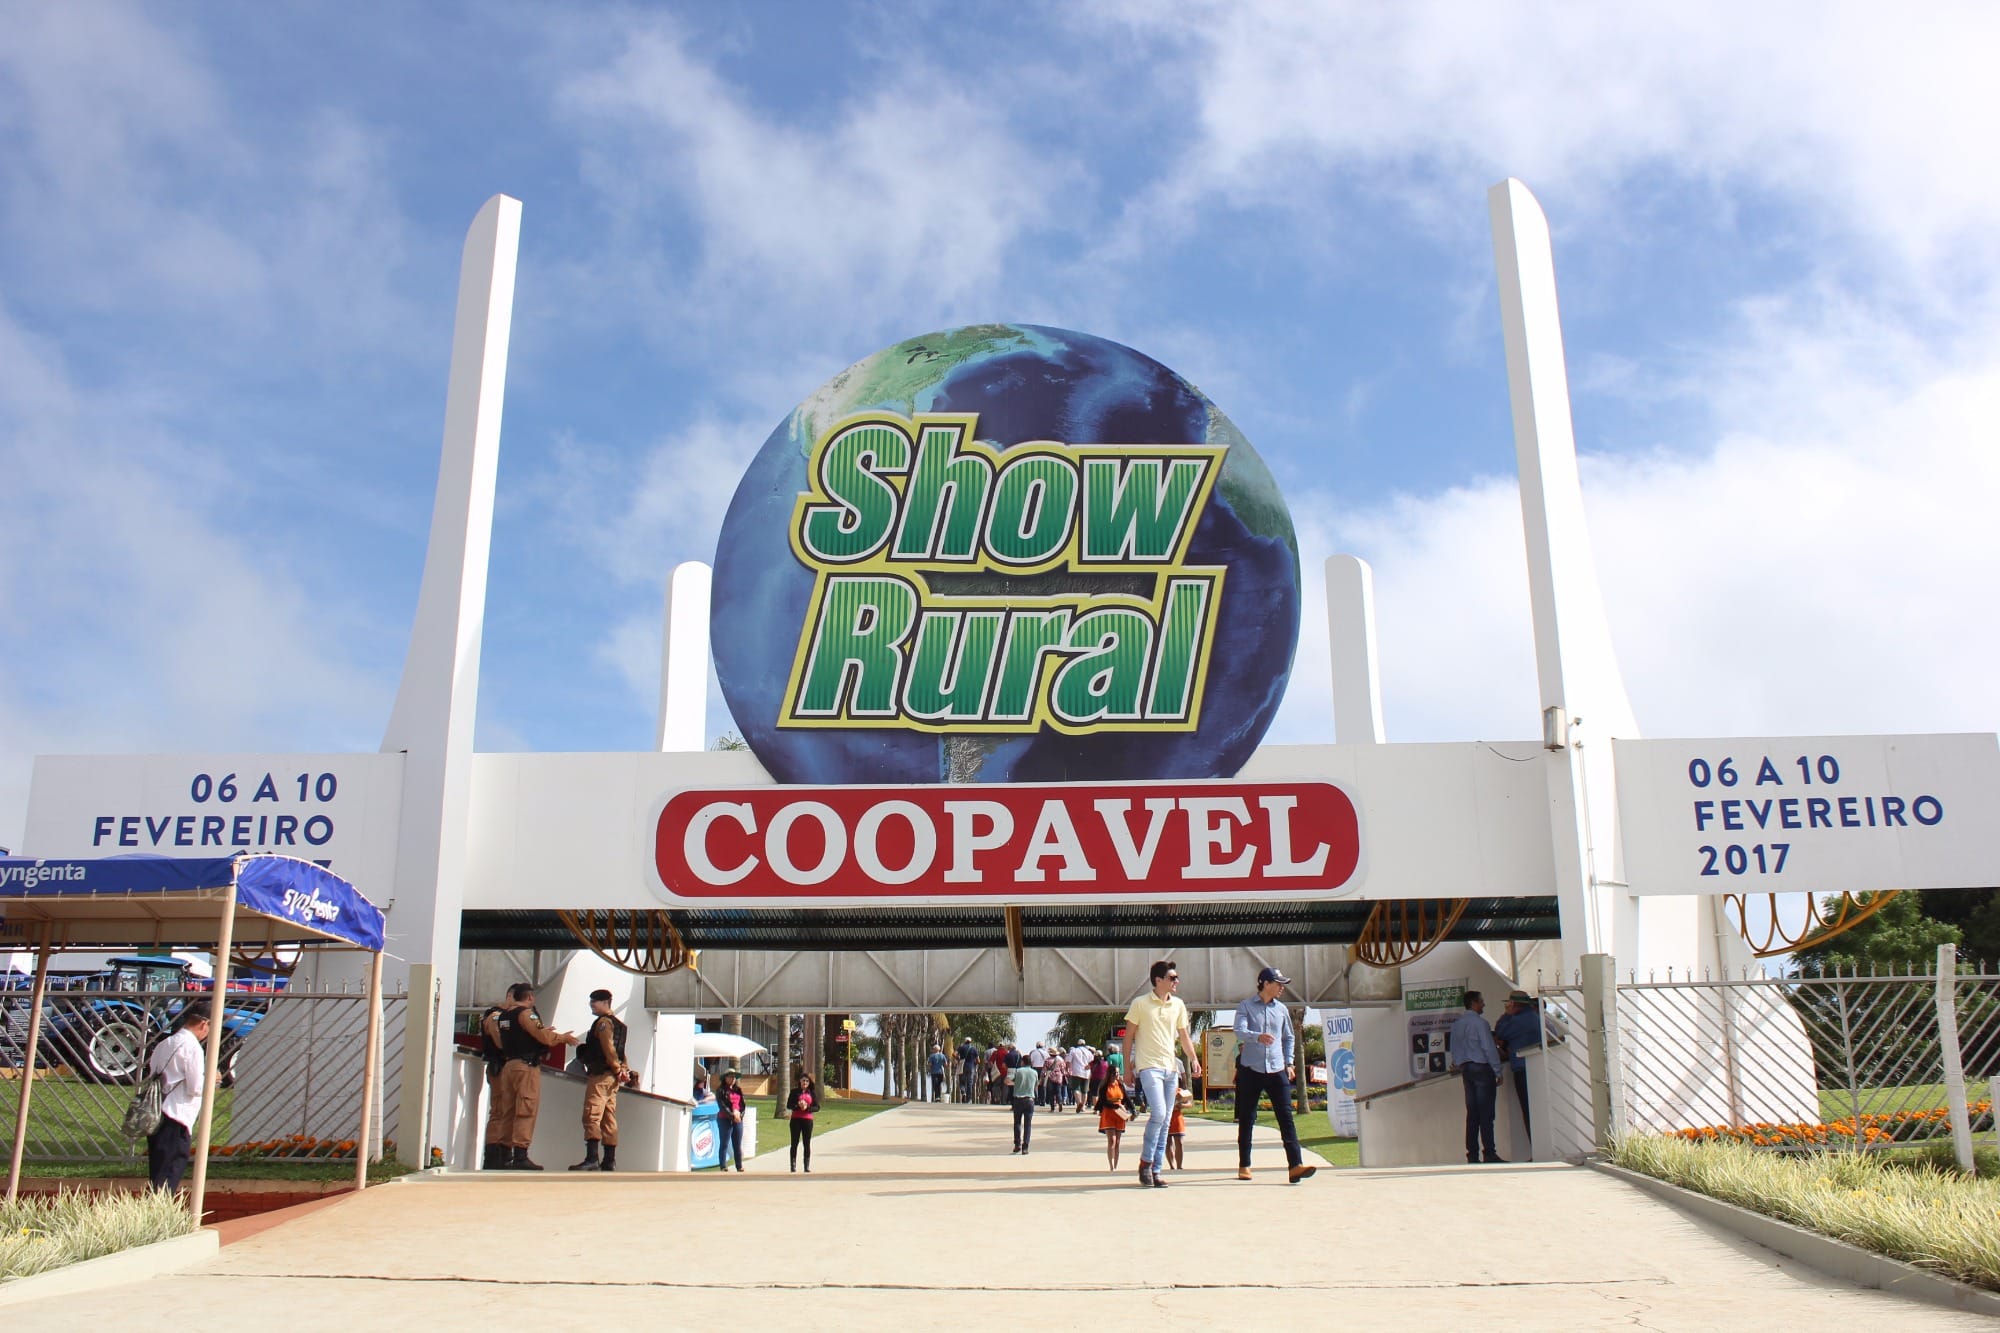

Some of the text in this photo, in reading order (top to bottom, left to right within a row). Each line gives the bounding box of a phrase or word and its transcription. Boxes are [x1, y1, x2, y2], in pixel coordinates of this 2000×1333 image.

[801, 422, 1210, 563] Show
[795, 574, 1211, 722] Rural
[190, 772, 338, 803] 06 A 10
[1688, 754, 1840, 788] 06 A 10
[1694, 794, 1944, 832] FEVEREIRO
[92, 814, 335, 847] FEVEREIRO
[682, 794, 1332, 886] COOPAVEL
[0, 860, 86, 888] yngenta
[1698, 843, 1791, 876] 2017
[282, 887, 340, 922] syngenta
